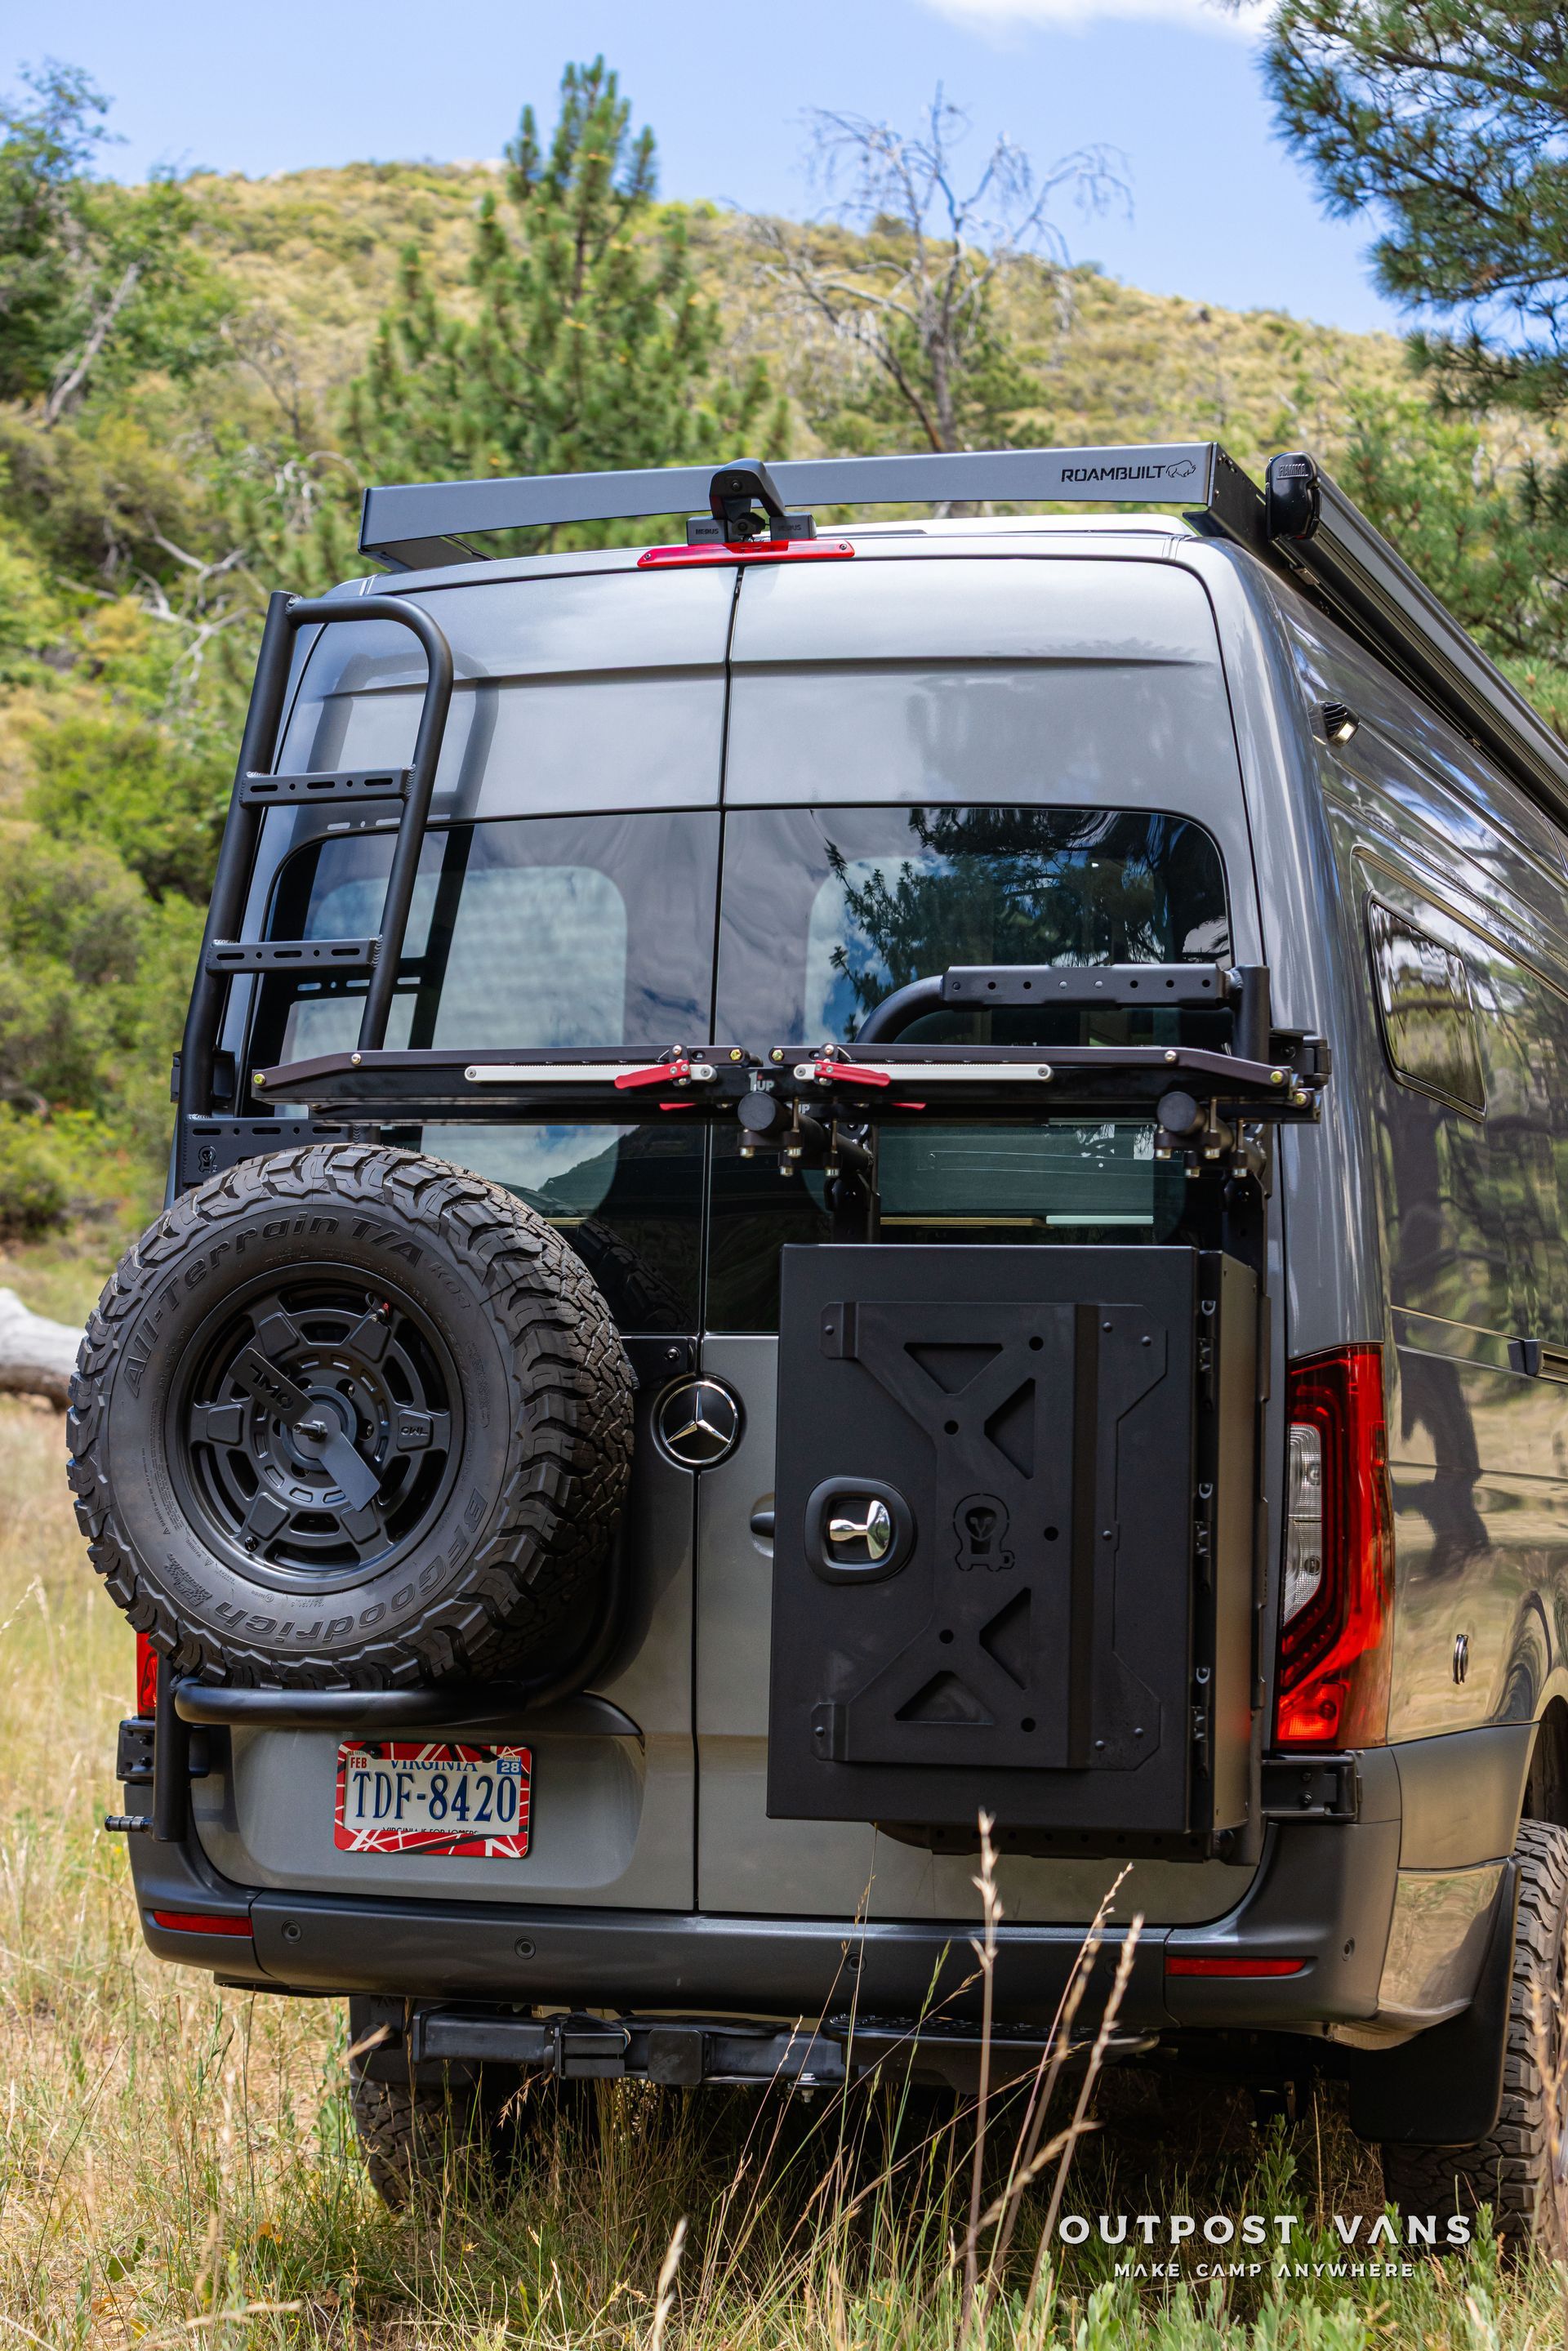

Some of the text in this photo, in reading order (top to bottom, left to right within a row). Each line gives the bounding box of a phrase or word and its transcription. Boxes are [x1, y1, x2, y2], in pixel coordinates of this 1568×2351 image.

[1062, 465, 1166, 483] ROAMBUILT
[125, 1212, 339, 1400] All-Terrain
[351, 1215, 425, 1268] T/A
[215, 1488, 484, 1642] BFGoodrich
[350, 1757, 367, 1768] FEB
[390, 1760, 479, 1772] VIRGINIA
[501, 1761, 519, 1773] 28
[352, 1770, 518, 1823] TDF-8420
